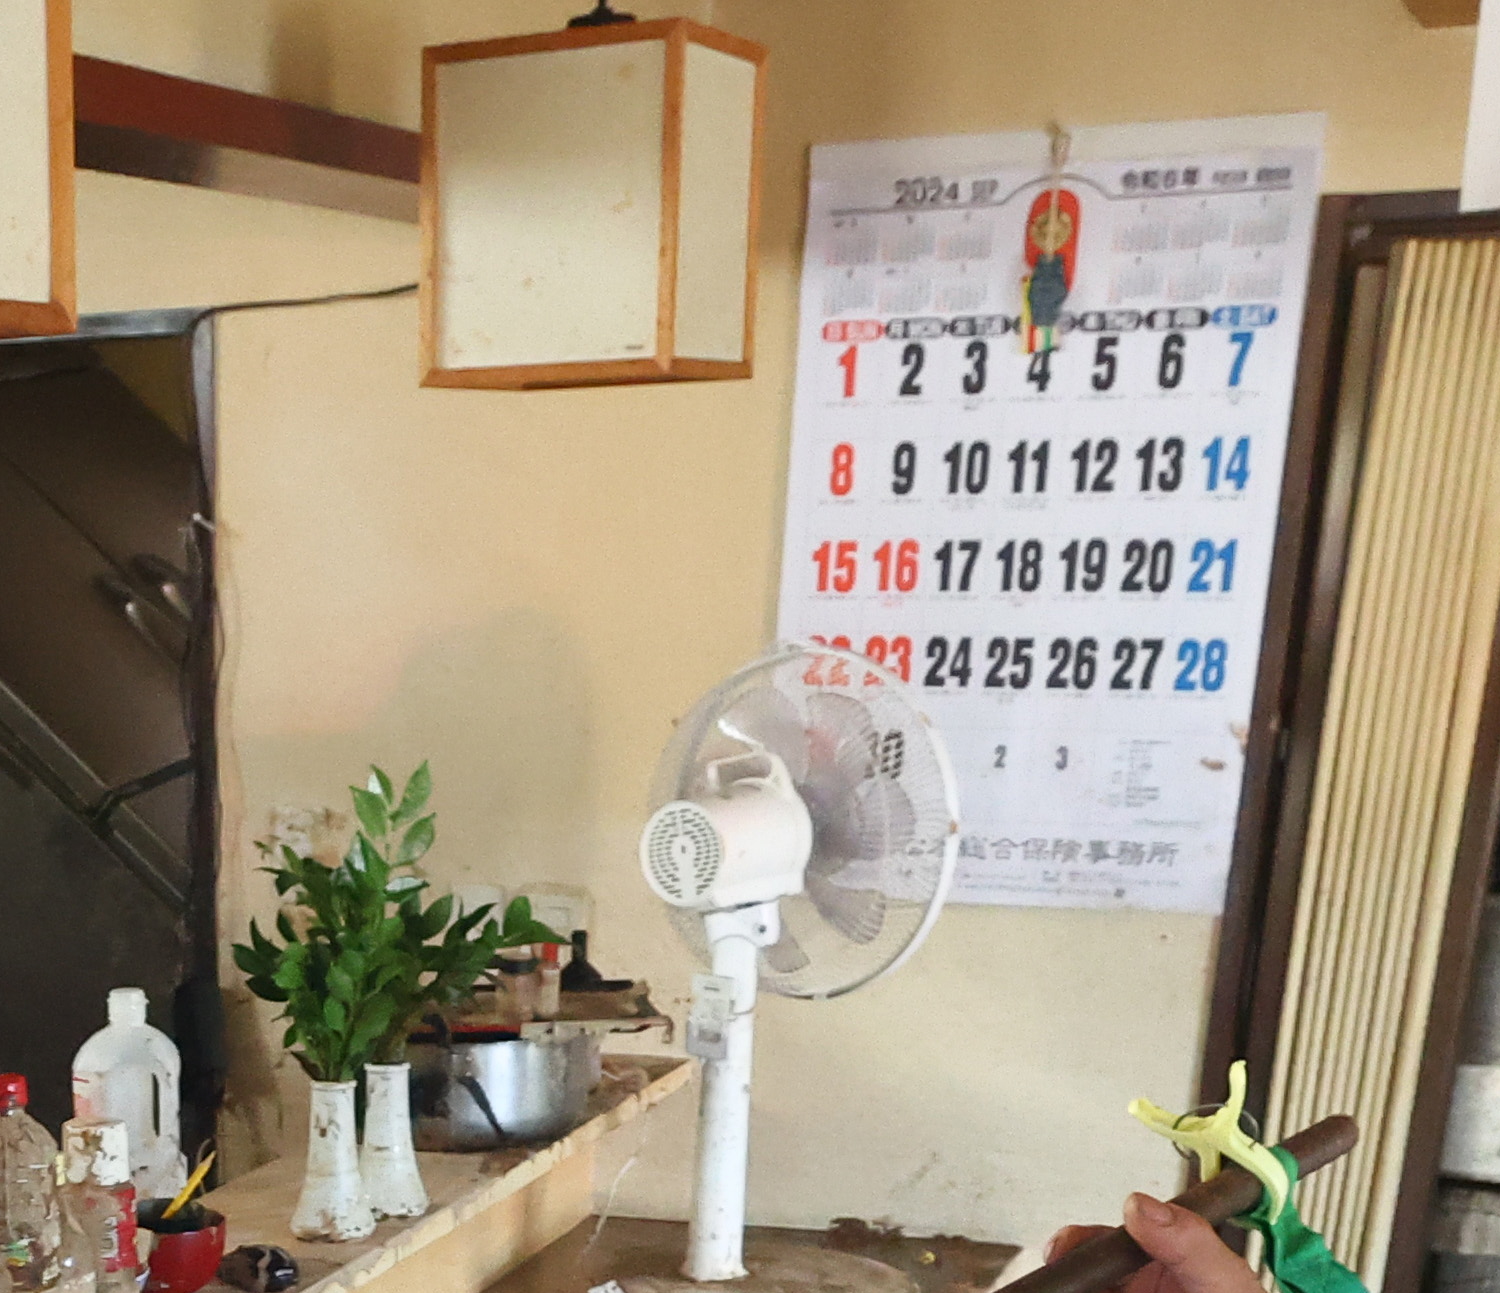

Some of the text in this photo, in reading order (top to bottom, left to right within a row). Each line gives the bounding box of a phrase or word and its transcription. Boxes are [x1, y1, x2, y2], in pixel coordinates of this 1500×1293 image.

[838, 346, 858, 397] 1
[900, 344, 924, 395] 2
[963, 341, 986, 394] 3
[1092, 337, 1117, 390] 5
[1159, 334, 1185, 388] 6
[1230, 332, 1253, 386] 7
[830, 437, 1251, 496] 8 9 10 11 12 13 14
[813, 540, 1236, 593] 15 16 17 18 19 20 21
[924, 637, 972, 687] 24
[985, 638, 1034, 689] 25
[1046, 638, 1097, 689] 26
[1110, 639, 1163, 689] 27
[1175, 639, 1227, 691] 28
[993, 744, 1007, 769] 2
[1055, 745, 1070, 770] 3
